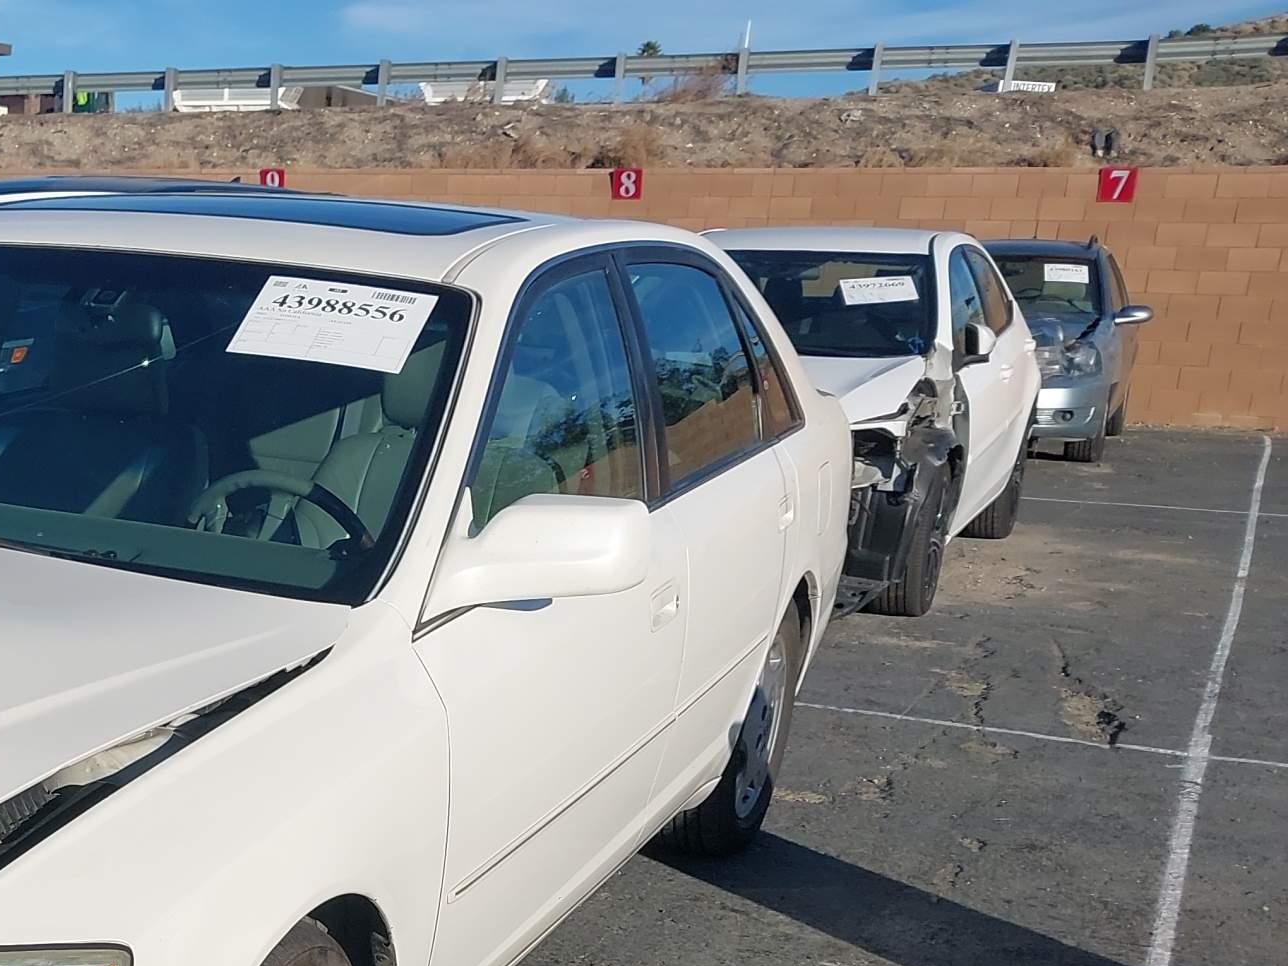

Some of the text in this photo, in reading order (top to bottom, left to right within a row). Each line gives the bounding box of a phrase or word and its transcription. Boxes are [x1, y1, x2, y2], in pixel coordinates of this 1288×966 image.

[619, 170, 636, 197] 8
[1109, 170, 1130, 200] 7
[272, 293, 408, 323] 43988556
